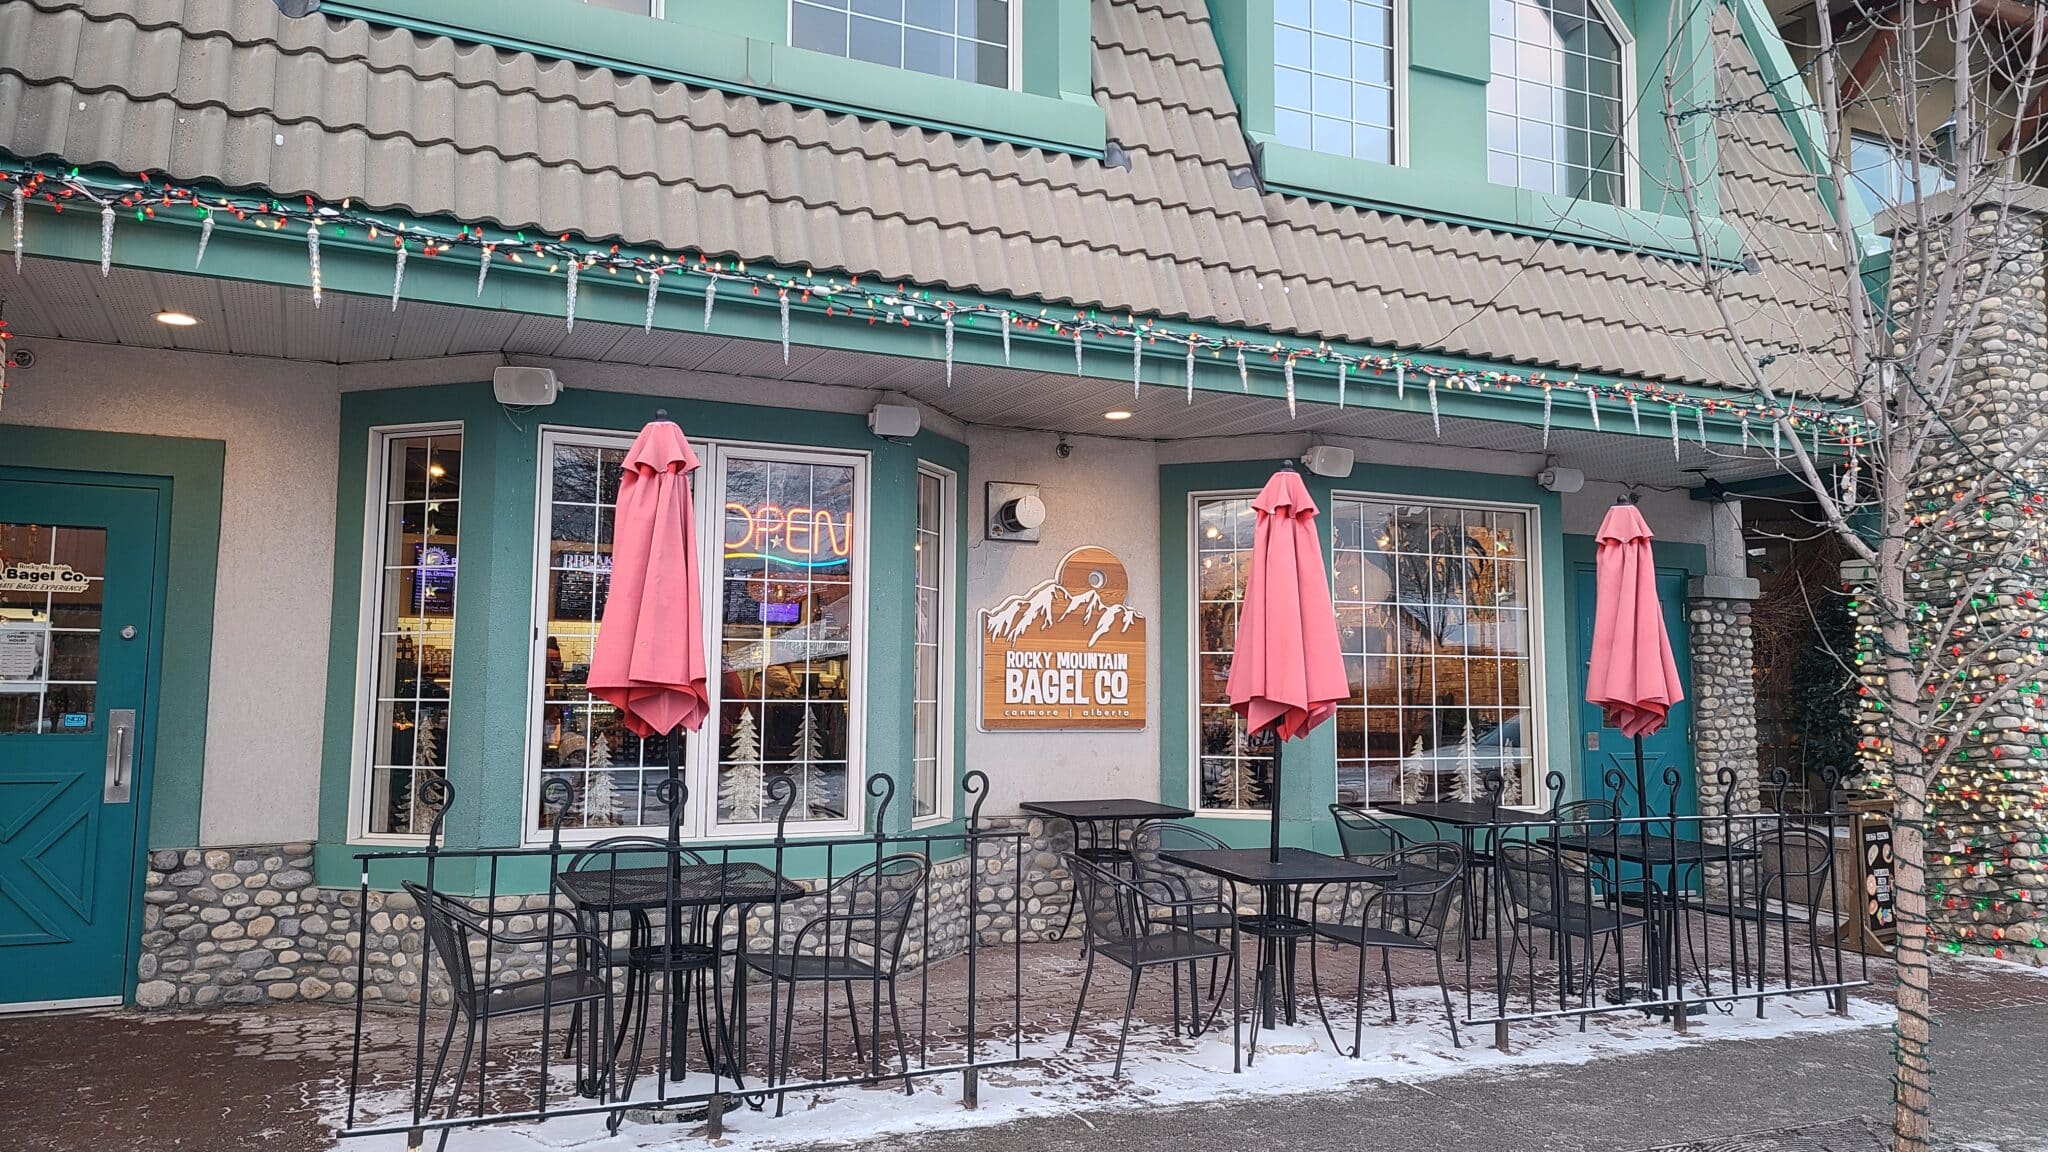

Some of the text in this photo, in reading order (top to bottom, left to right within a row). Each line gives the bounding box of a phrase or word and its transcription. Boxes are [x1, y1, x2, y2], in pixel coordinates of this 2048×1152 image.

[725, 503, 852, 556] OPEN
[6, 568, 88, 583] Bagel Co.
[1006, 650, 1128, 670] ROCKY MOUNTAIN
[1005, 668, 1129, 705] BAGEL CO
[1004, 708, 1130, 717] canmore alberta
